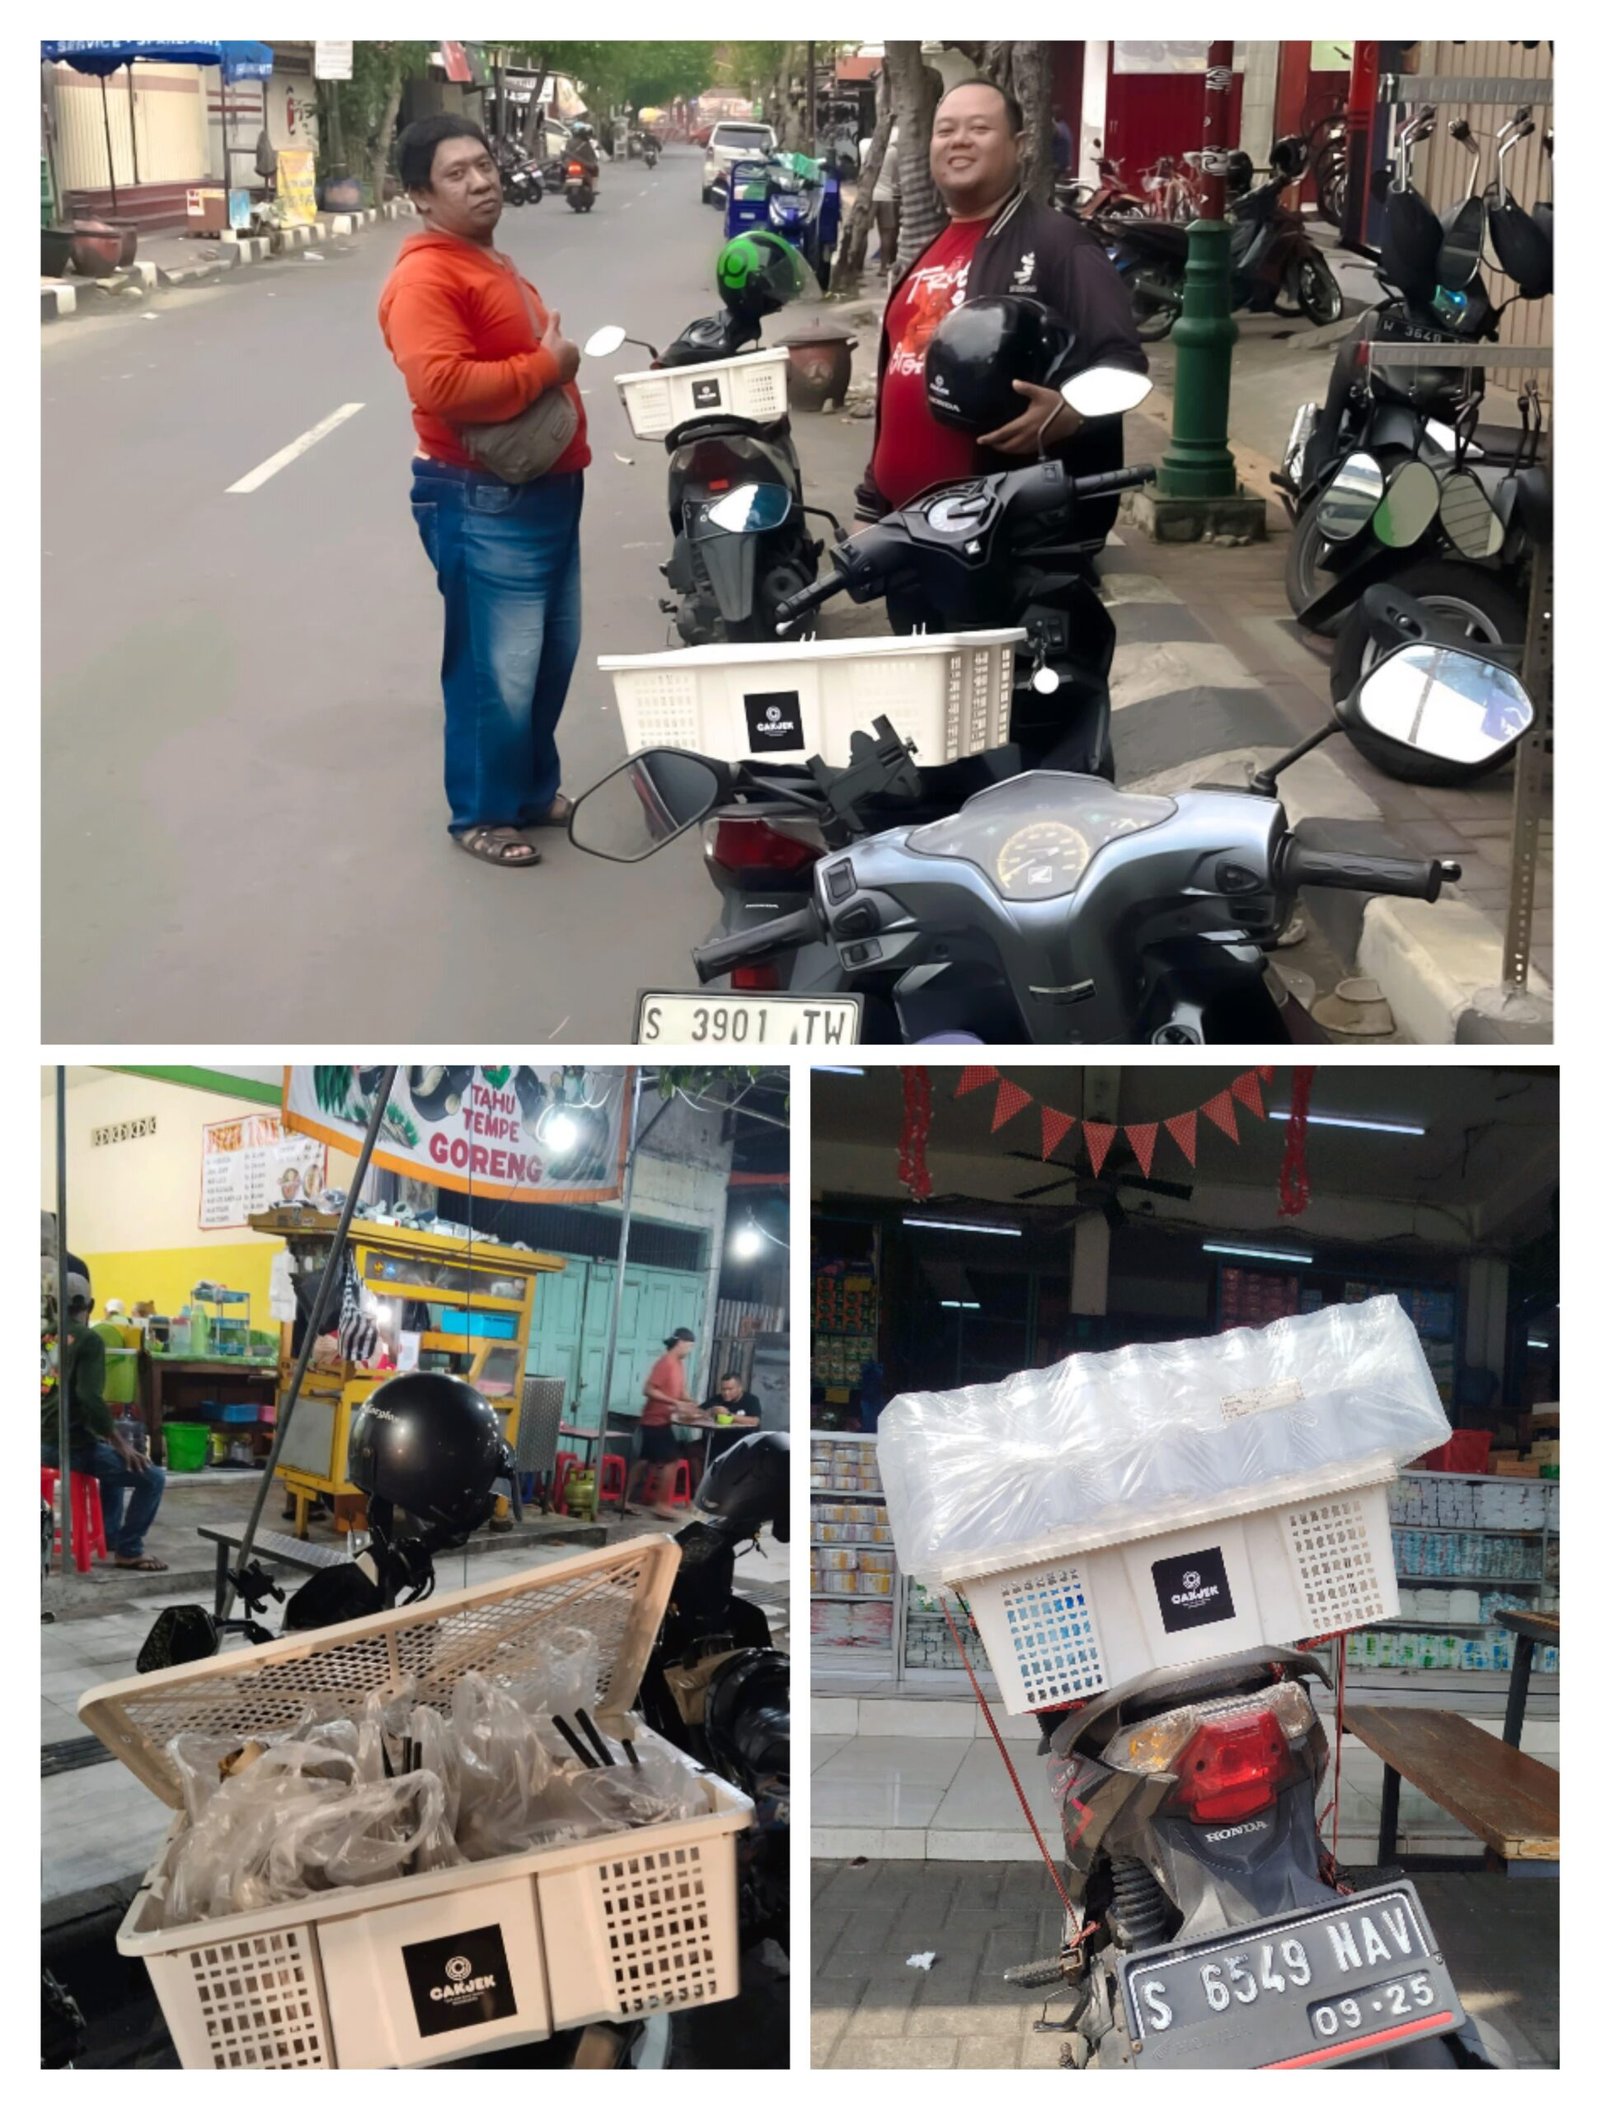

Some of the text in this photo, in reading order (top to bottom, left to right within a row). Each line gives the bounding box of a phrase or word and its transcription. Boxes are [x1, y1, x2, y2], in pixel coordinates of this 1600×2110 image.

[645, 1007, 845, 1044] S 3901 TW
[471, 1084, 516, 1114] TAHU
[462, 1107, 521, 1143] TEMPE
[429, 1132, 543, 1183] GORENG
[1171, 1585, 1219, 1604] CAKJEK
[1205, 1820, 1268, 1842] HONDA
[429, 1974, 496, 2001] CAKJEK
[1142, 1980, 1173, 2031] S
[1200, 1938, 1312, 2012] 6549
